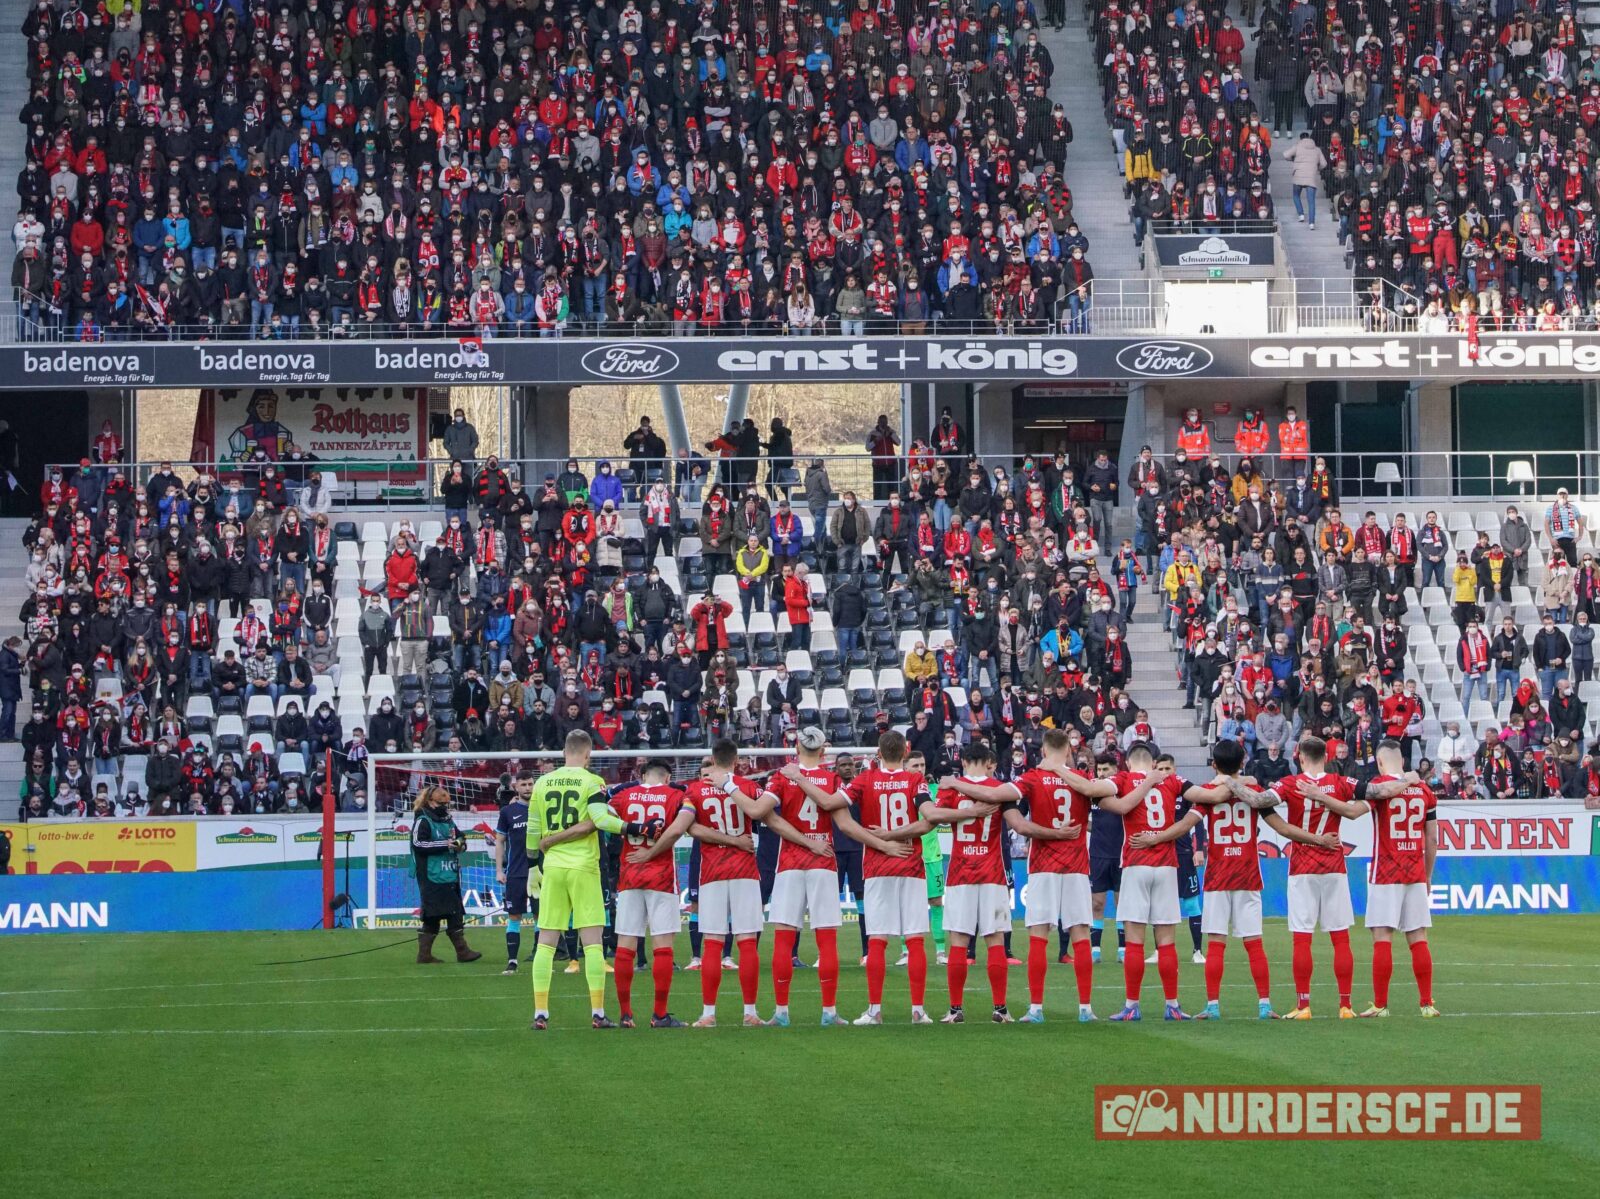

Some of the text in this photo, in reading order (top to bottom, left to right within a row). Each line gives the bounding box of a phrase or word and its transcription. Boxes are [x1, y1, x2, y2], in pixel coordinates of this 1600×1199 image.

[1181, 255, 1248, 264] Schwarzwaldmilch
[24, 350, 140, 372] badenova
[200, 349, 315, 371] badenova
[600, 347, 662, 374] Ford
[717, 343, 878, 371] ernst
[928, 342, 1078, 375] könig
[1133, 344, 1194, 372] Ford
[1250, 340, 1410, 369] ernst
[141, 374, 155, 383] Tag
[317, 372, 330, 381] Tag
[491, 371, 504, 380] Tag
[310, 403, 410, 439] Rothaus
[310, 440, 412, 451] TANNENZÄPFLE
[554, 778, 583, 786] FREIBURG
[701, 787, 710, 796] SC
[873, 780, 909, 790] SC FREIBURG
[1042, 776, 1051, 785] SC
[629, 792, 667, 802] SC FREIBURG
[1144, 787, 1166, 828] 8
[545, 790, 580, 831] 26
[702, 796, 745, 837] 30
[798, 796, 819, 830] 4
[879, 792, 910, 832] 18
[1052, 788, 1072, 829] 3
[1302, 797, 1331, 836] 17
[1389, 797, 1425, 839] 22
[135, 828, 176, 839] LOTTO
[1213, 801, 1252, 844] 29
[38, 831, 95, 841] lotto-bw.de
[963, 845, 989, 856] HÖFLER
[1223, 847, 1242, 856] JEONG
[0, 902, 108, 929] MANN
